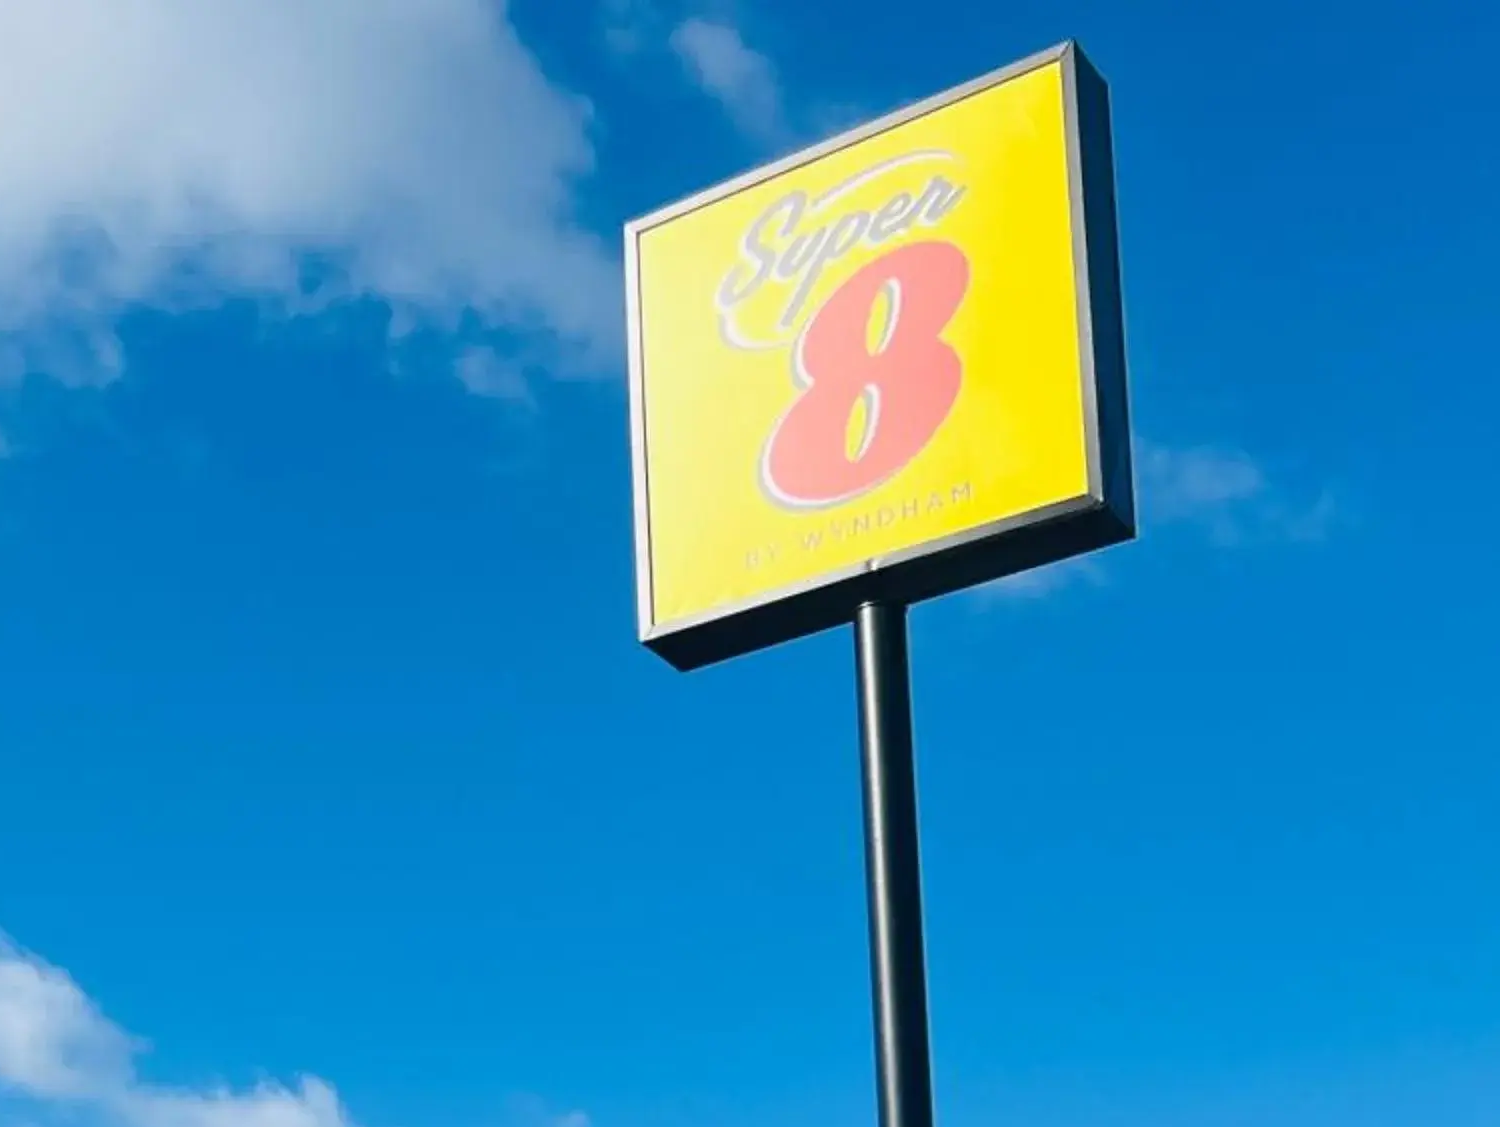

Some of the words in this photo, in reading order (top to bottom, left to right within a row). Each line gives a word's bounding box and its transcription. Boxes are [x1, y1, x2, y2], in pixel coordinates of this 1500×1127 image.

[715, 173, 967, 332] Super
[757, 240, 971, 510] 8
[800, 479, 976, 553] WYNDHAM
